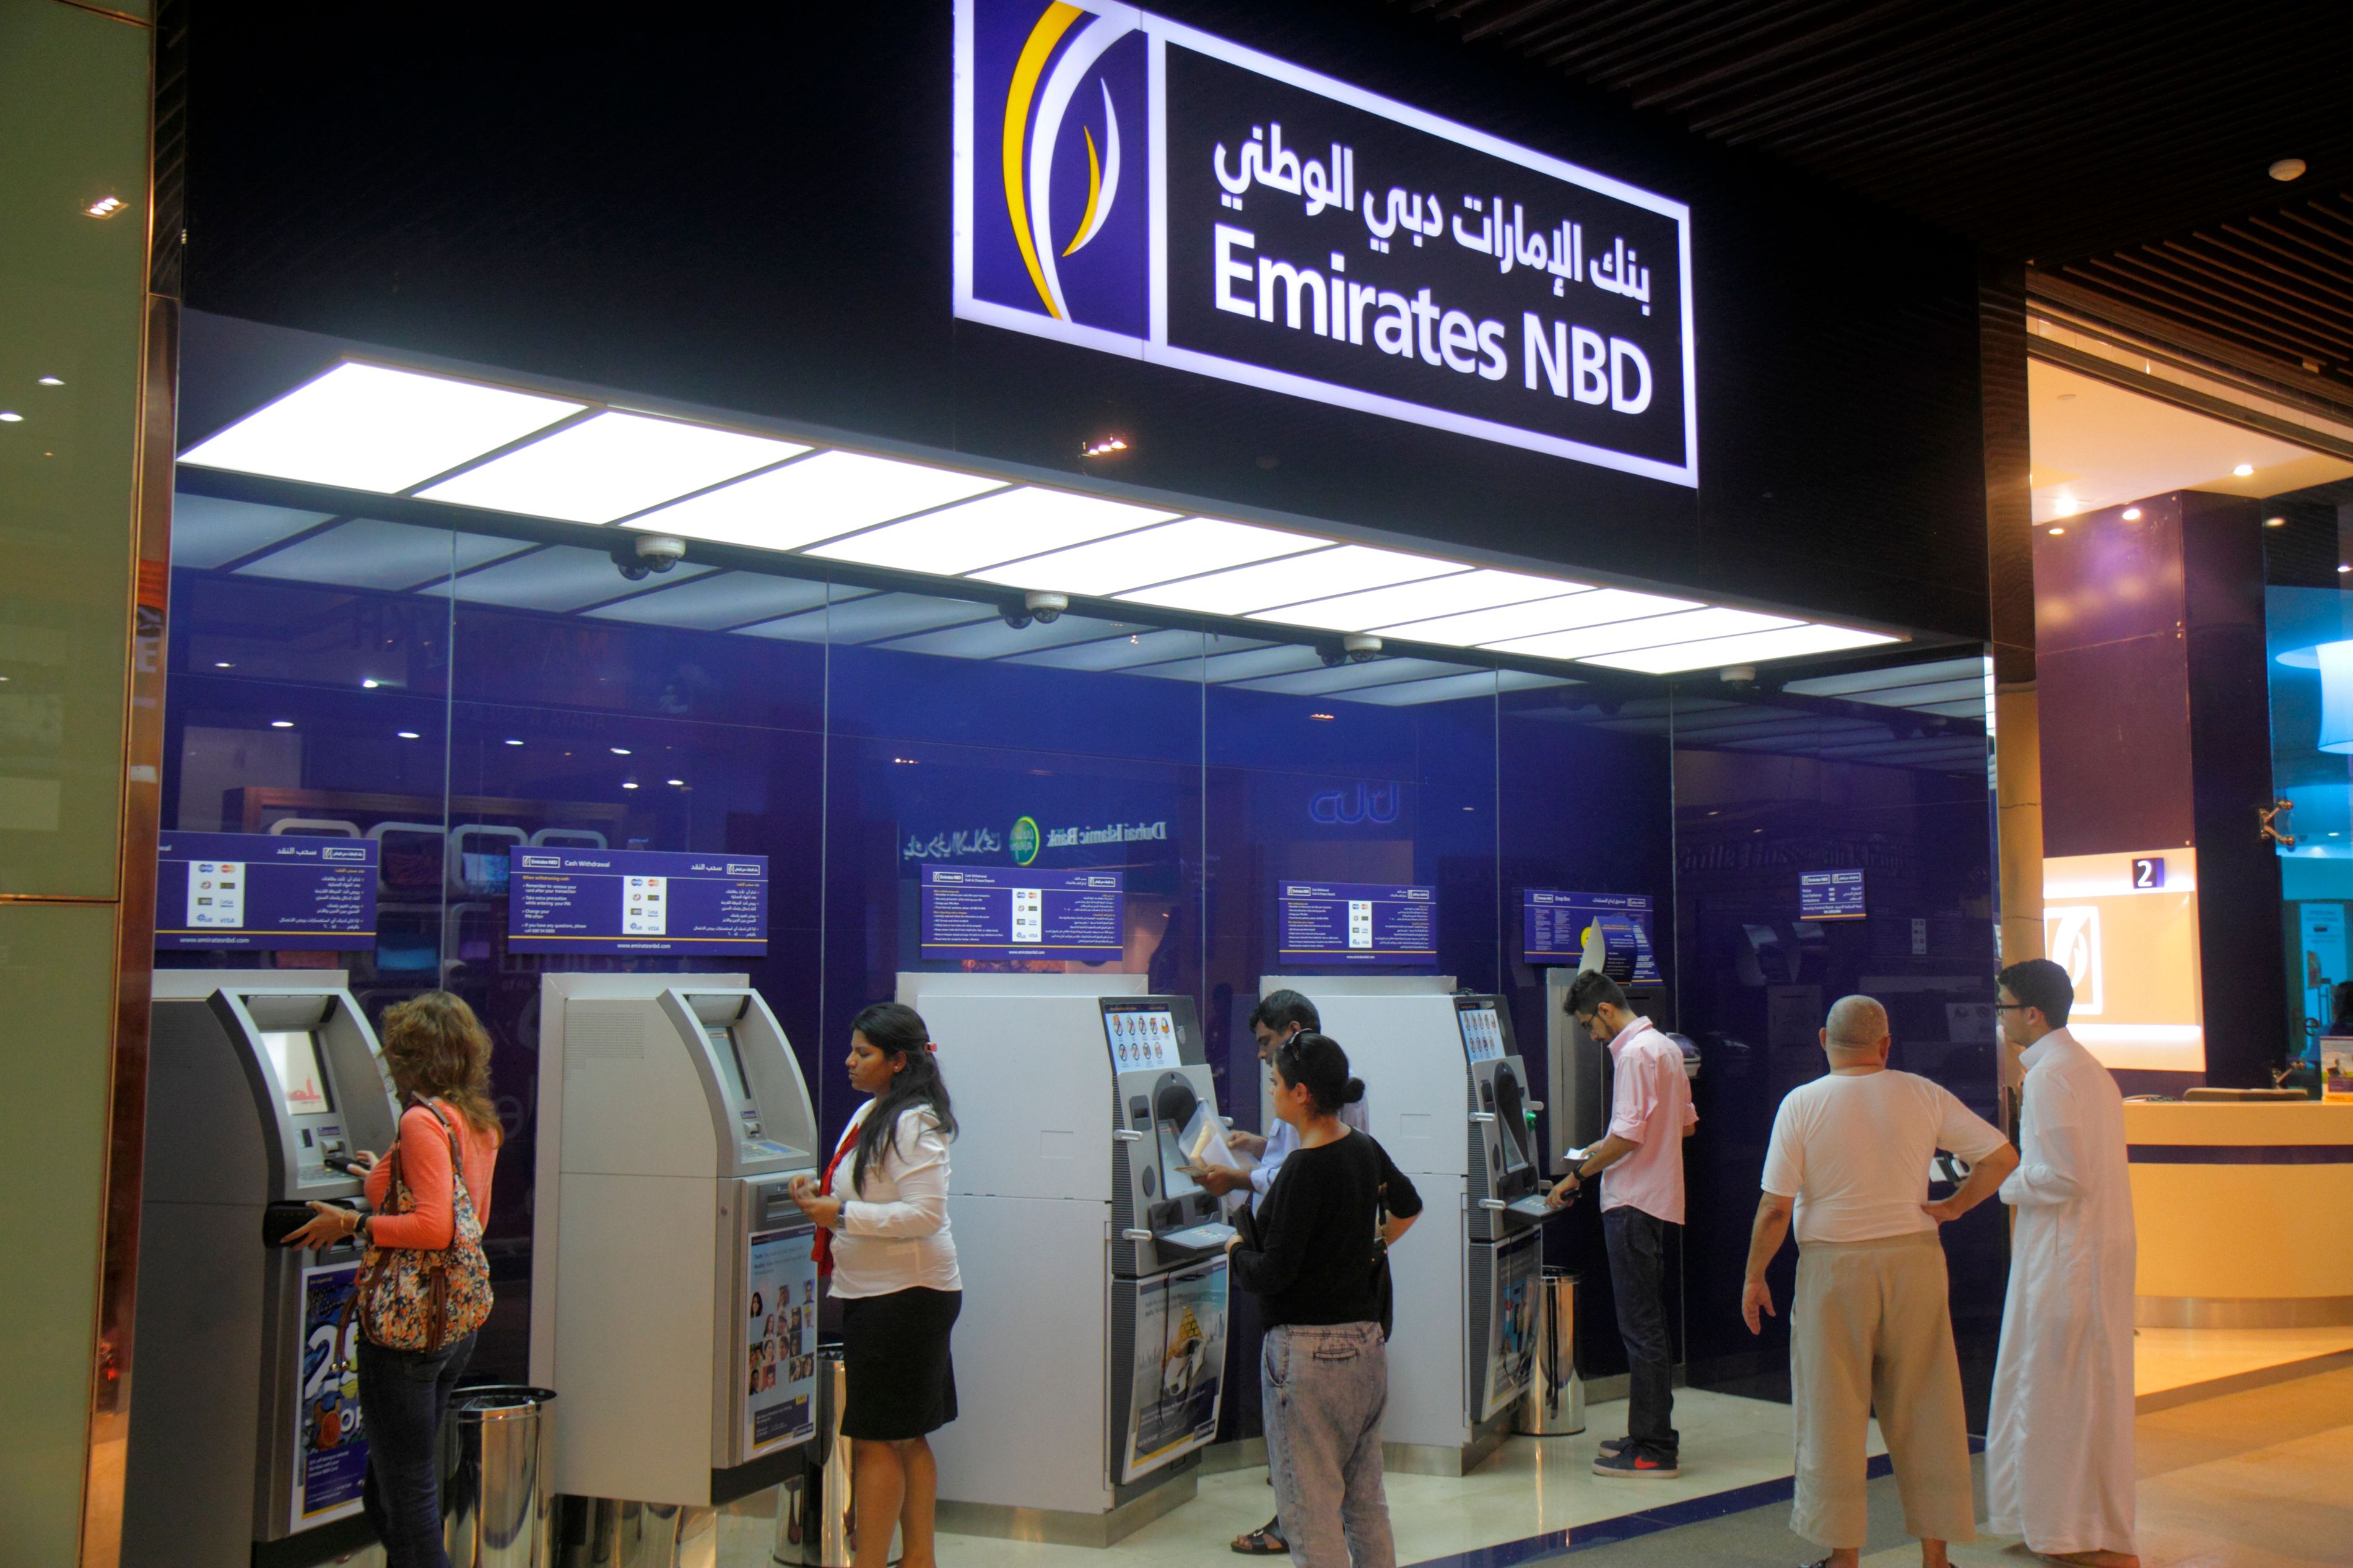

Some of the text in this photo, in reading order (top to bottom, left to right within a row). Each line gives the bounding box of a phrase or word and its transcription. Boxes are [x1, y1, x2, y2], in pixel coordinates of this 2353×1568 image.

[1214, 123, 1651, 316] بنك الإمارات دبي الوطني
[1214, 223, 1653, 414] Emirates NBD
[276, 847, 295, 855] النقد
[2137, 860, 2153, 887] 2
